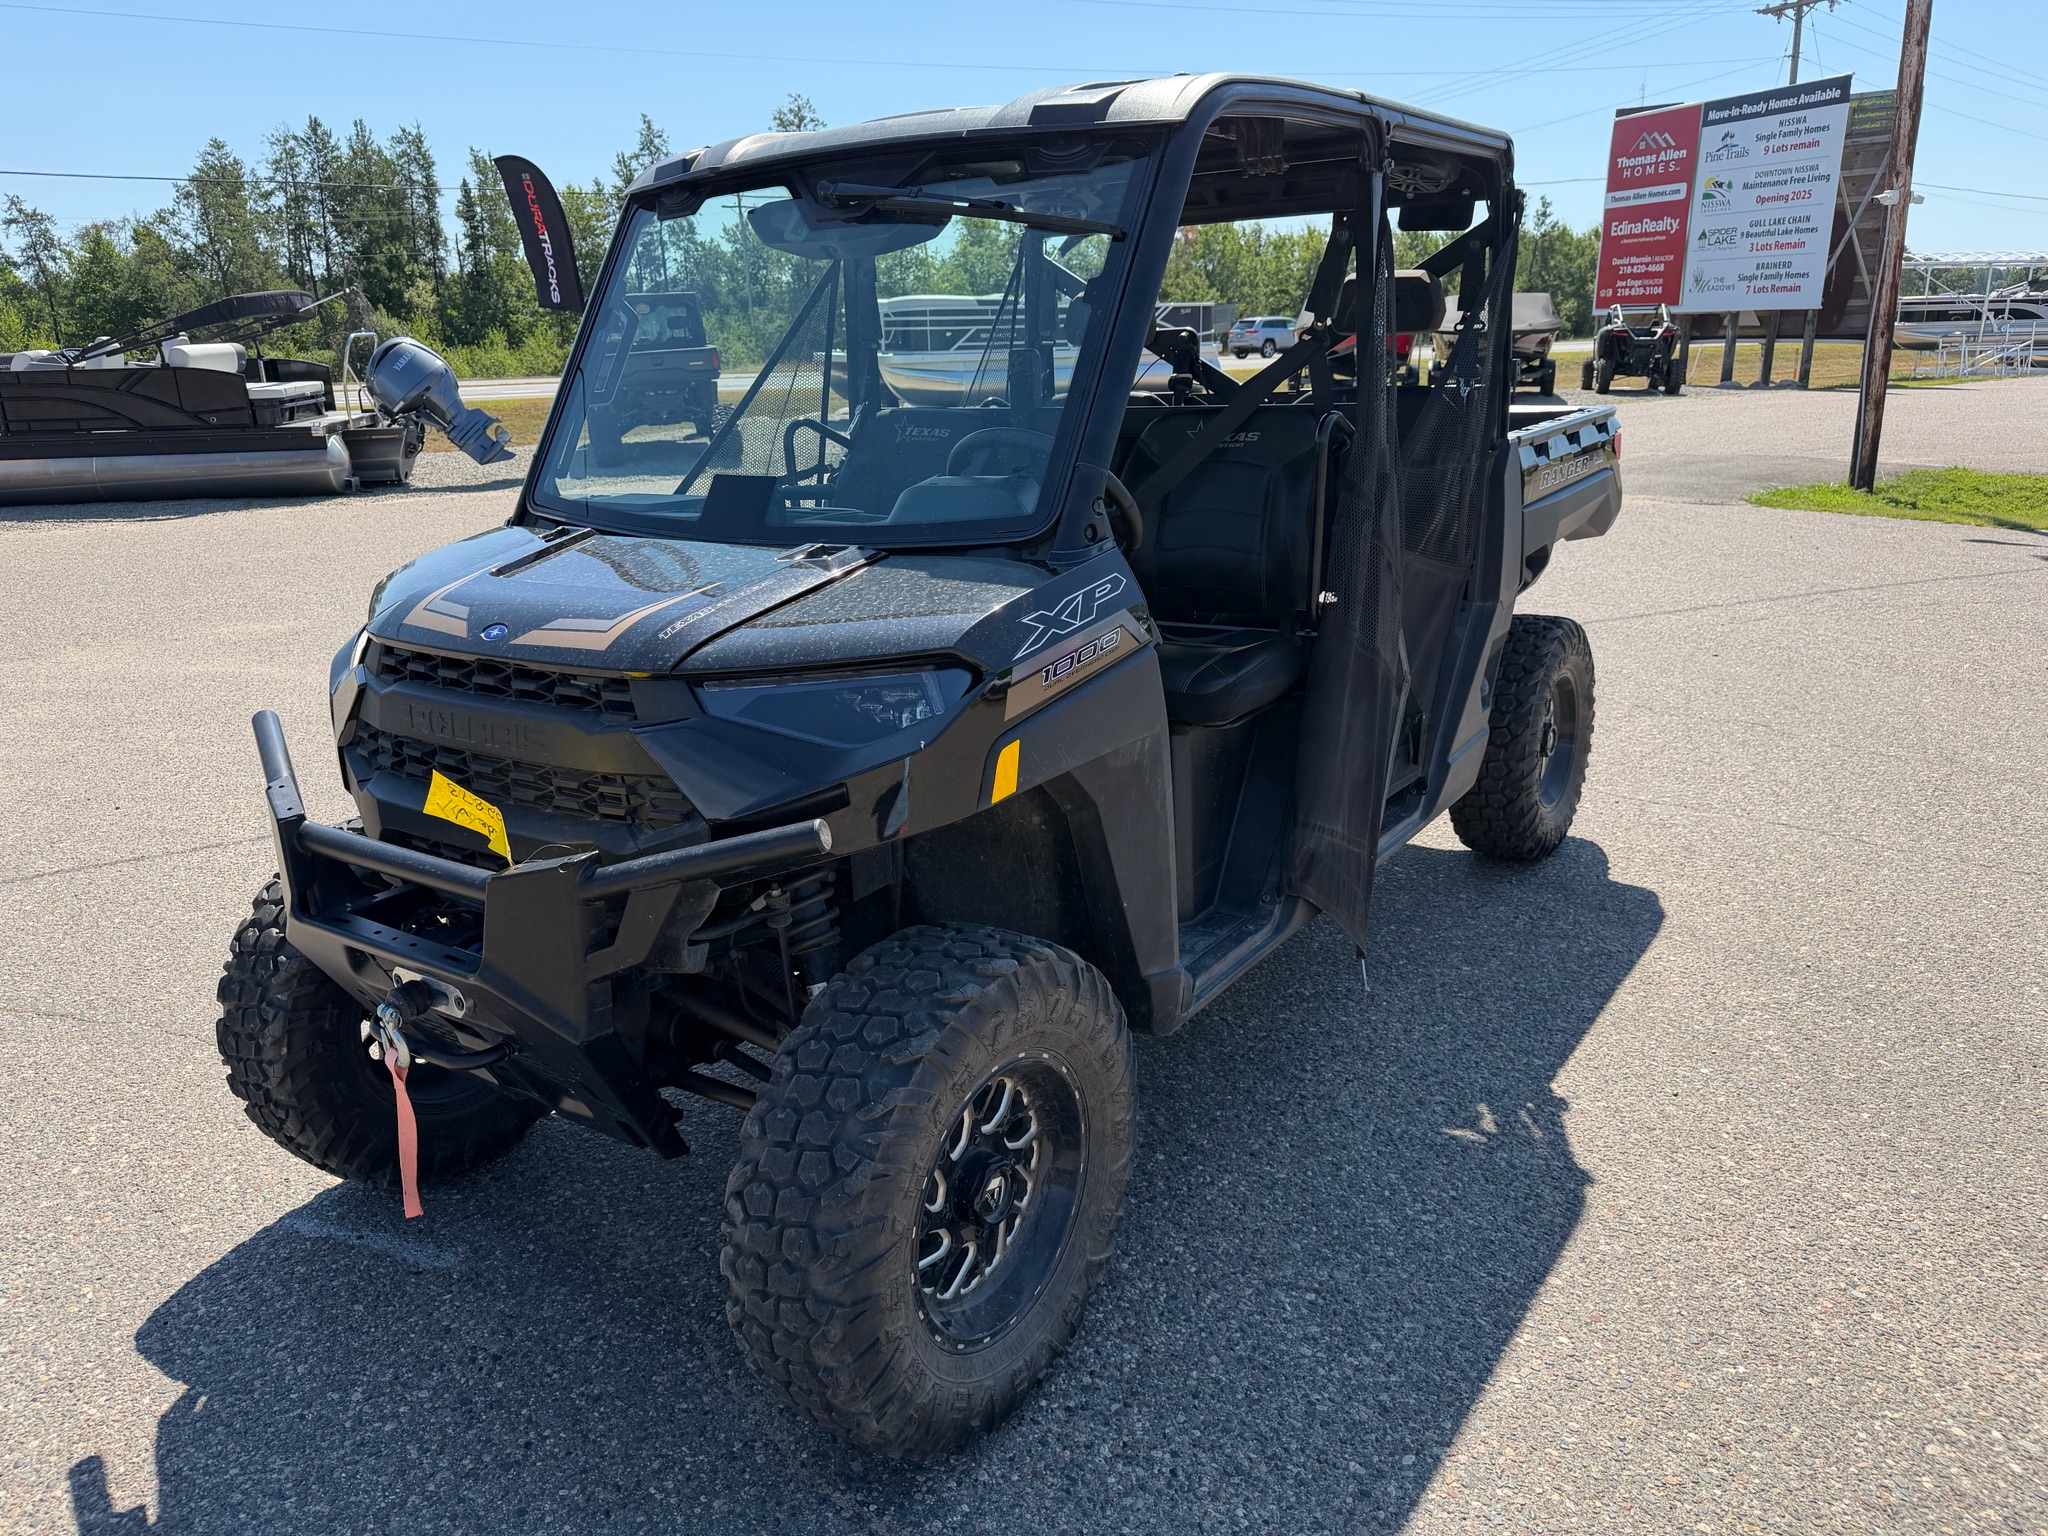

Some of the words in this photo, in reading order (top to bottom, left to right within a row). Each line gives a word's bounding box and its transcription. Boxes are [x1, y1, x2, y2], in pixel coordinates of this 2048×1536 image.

[1708, 101, 1768, 121] Move-in-Ready
[1768, 98, 1797, 110] Homes
[1798, 87, 1841, 104] Available
[1779, 116, 1807, 127] NISSWA
[1755, 131, 1777, 143] Single
[1778, 127, 1803, 139] Family
[1804, 124, 1830, 136] Homes
[1705, 151, 1724, 163] Pine
[1725, 146, 1750, 159] Trails
[1763, 145, 1770, 155] 9
[1771, 143, 1789, 154] Lots
[1790, 138, 1820, 151] remain
[1616, 154, 1657, 168] Thomas
[1658, 149, 1687, 162] Allen
[1623, 161, 1676, 178] HOMES
[1755, 167, 1793, 179] DOWNTOWN
[1794, 164, 1819, 174] NISSWA
[1742, 178, 1788, 190] Maintenance
[1789, 175, 1806, 185] Free
[1807, 173, 1831, 183] Living
[1700, 199, 1731, 210] NISSWA
[1755, 192, 1789, 206] Opening
[1790, 189, 1812, 200] 2025
[1749, 219, 1767, 228] GULL
[1768, 217, 1786, 227] LAKE
[1787, 215, 1811, 225] CHAIN
[1708, 227, 1738, 237] SPIDER
[1740, 231, 1745, 240] 9
[1745, 228, 1776, 239] Beautiful
[1777, 226, 1793, 236] Lake
[1794, 226, 1818, 235] Homes
[522, 180, 561, 304] DURATRACKS
[1707, 235, 1737, 246] LAKE
[1749, 242, 1755, 252] 3
[1755, 241, 1772, 252] Lots
[1773, 238, 1806, 250] Remain
[1612, 256, 1629, 265] David
[1755, 261, 1793, 271] BRAINERD
[1616, 279, 1626, 287] Joe
[1713, 276, 1725, 284] THE
[1738, 273, 1759, 284] Single
[1760, 271, 1784, 282] Family
[1784, 270, 1810, 279] Homes
[1745, 285, 1751, 295] 7
[1753, 284, 1769, 294] Lots
[1770, 283, 1801, 293] Remain
[393, 350, 416, 371] YAMAHA
[905, 427, 951, 437] TEXAS
[1540, 455, 1589, 490] RANGER
[659, 606, 715, 639] TEXAS
[1012, 573, 1126, 661] XP
[1042, 627, 1120, 686] 1000
[409, 704, 546, 757] POLARIS
